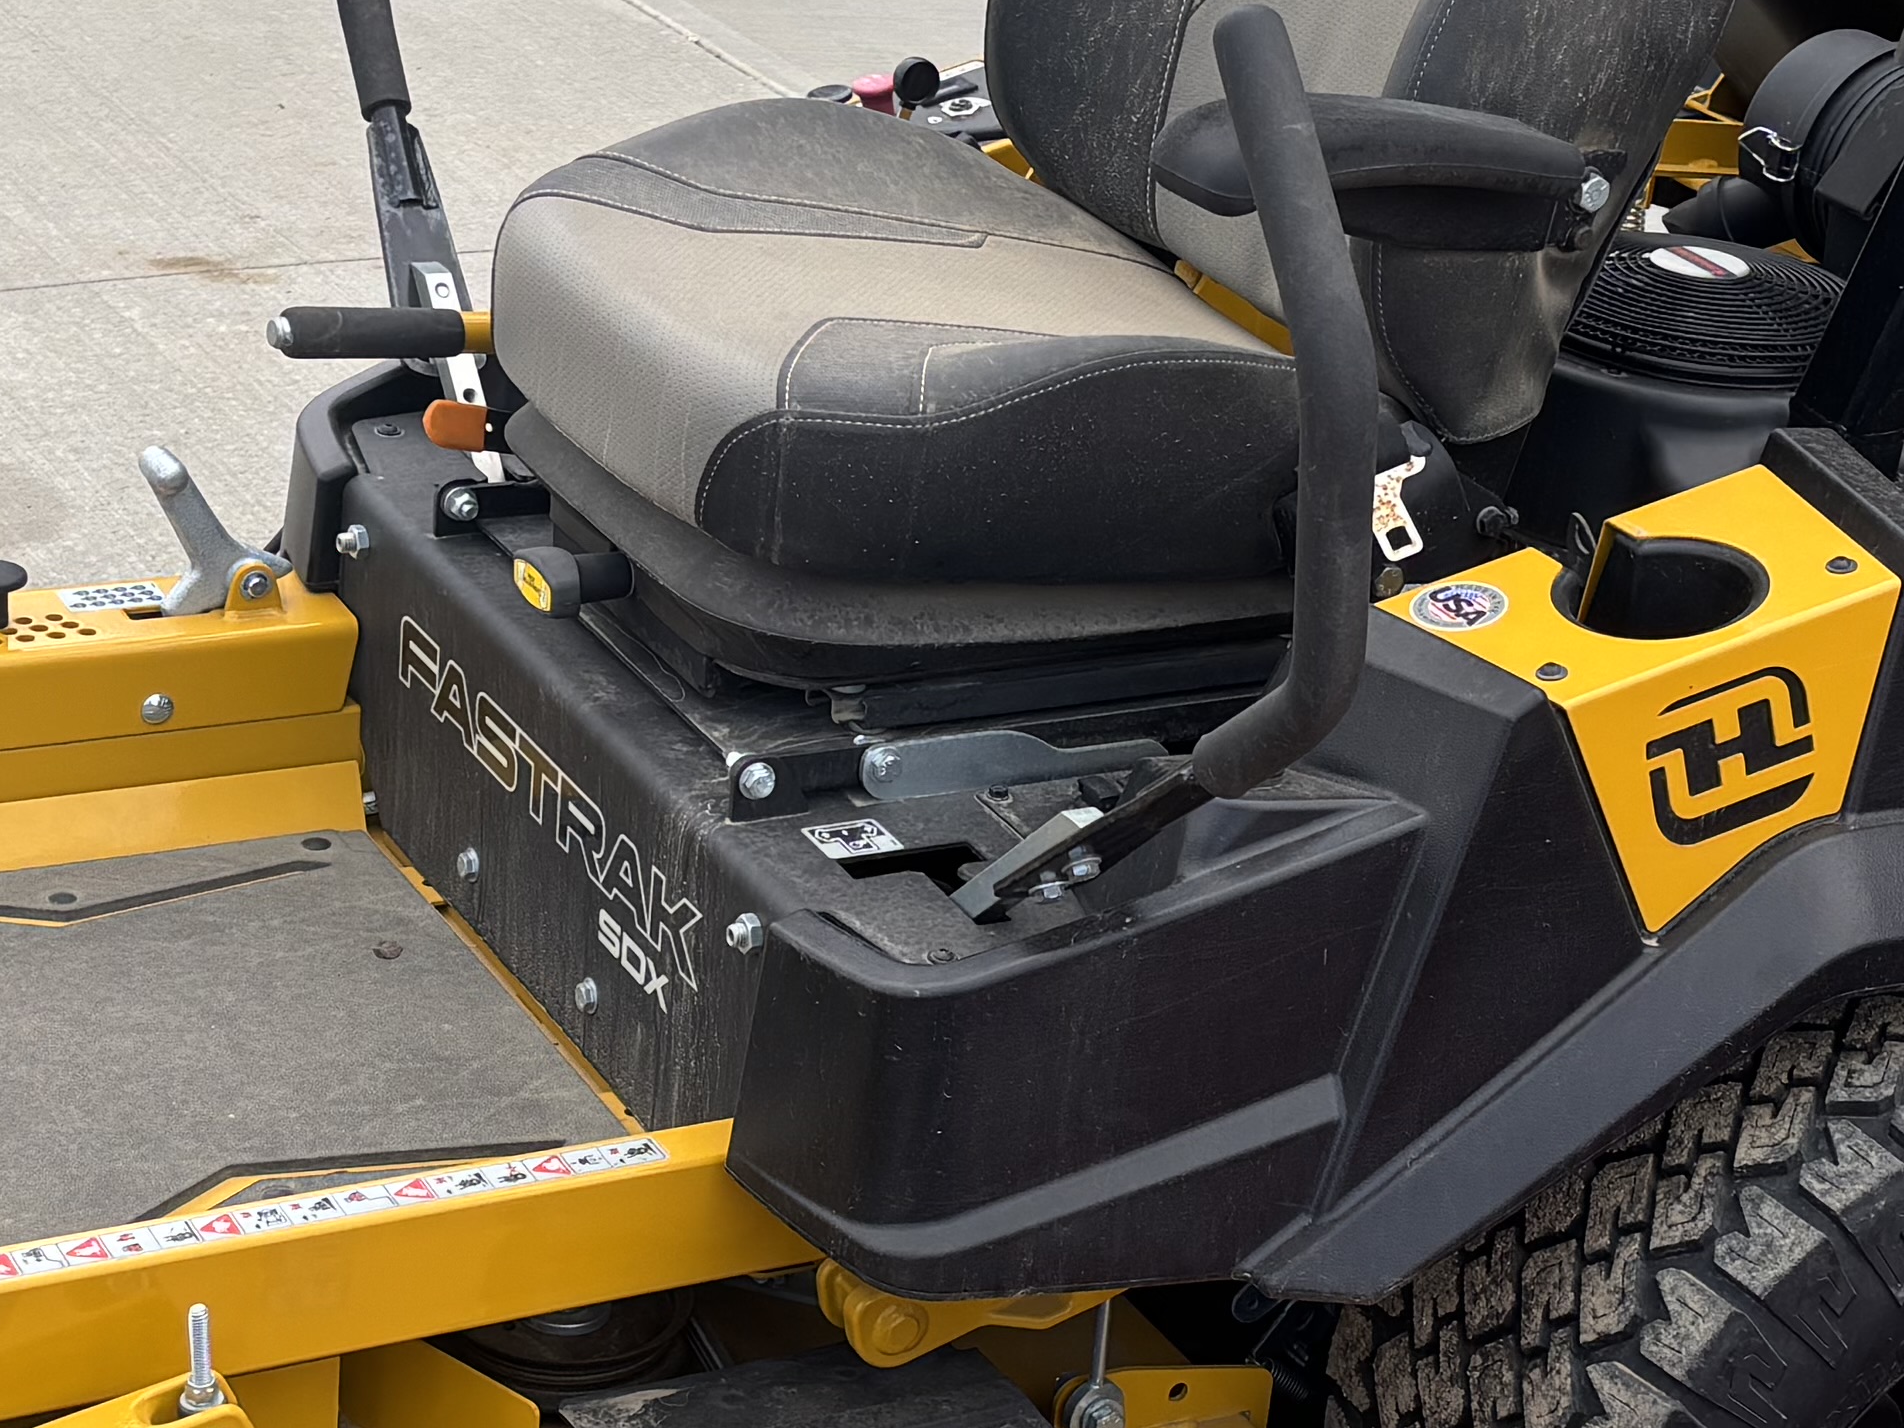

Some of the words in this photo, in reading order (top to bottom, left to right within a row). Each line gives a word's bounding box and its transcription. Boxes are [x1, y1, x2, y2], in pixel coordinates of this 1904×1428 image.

[1428, 585, 1487, 627] USA
[398, 615, 703, 992] FASTRAK
[598, 908, 668, 1015] SDX
